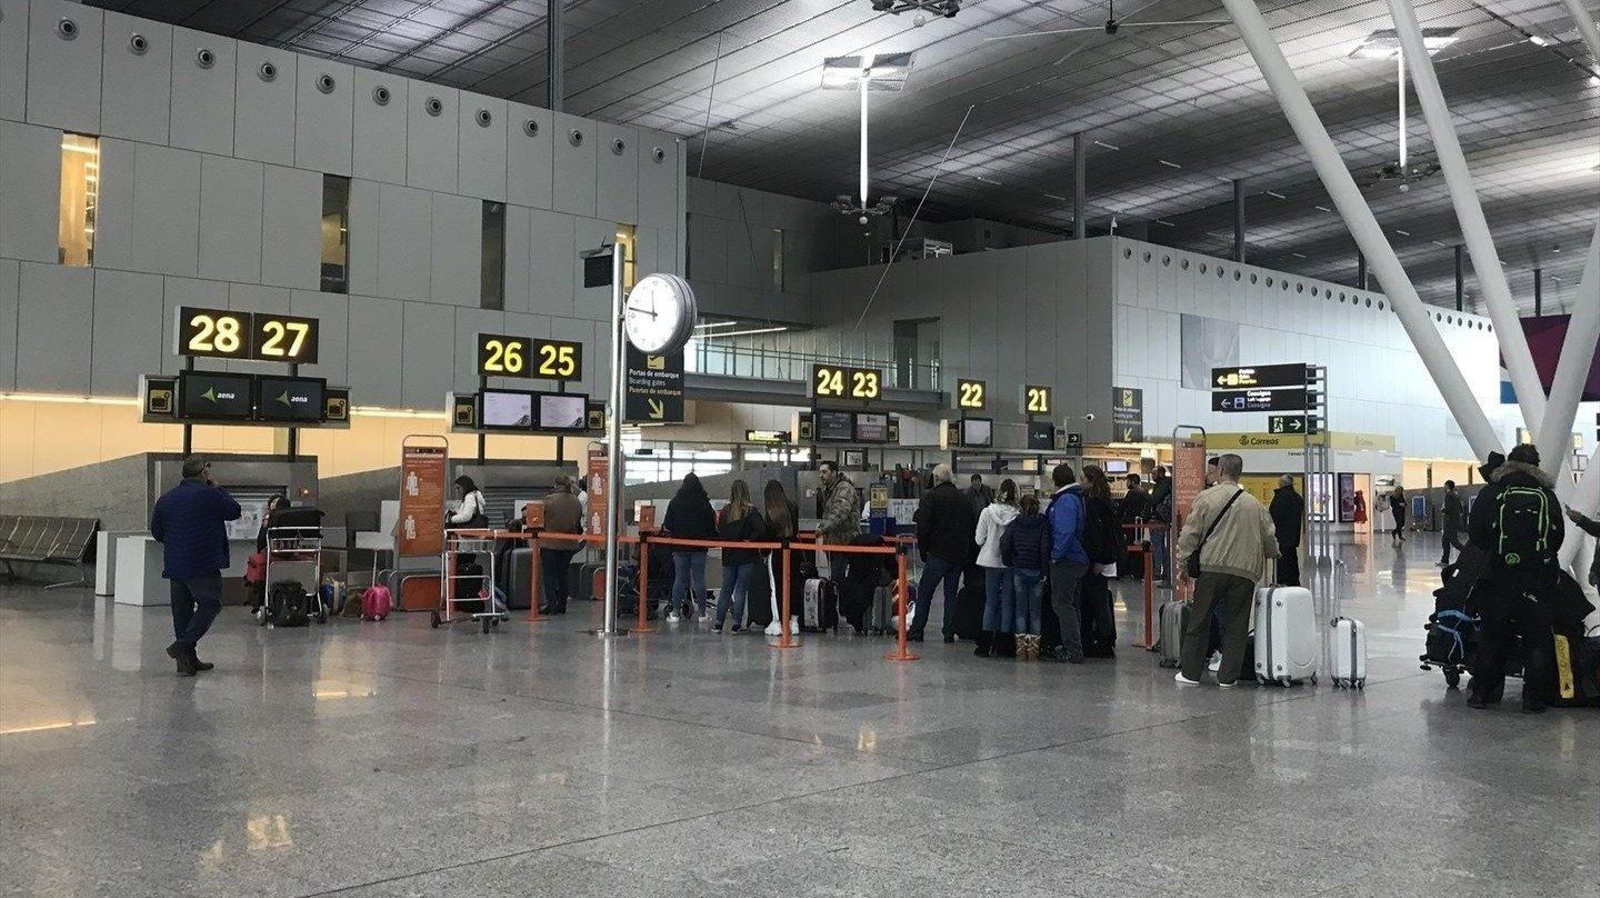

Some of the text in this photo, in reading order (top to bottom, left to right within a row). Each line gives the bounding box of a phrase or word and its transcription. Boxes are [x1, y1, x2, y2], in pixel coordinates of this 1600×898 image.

[188, 314, 240, 353] 28
[261, 320, 309, 357] 27
[484, 340, 523, 373] 26
[539, 344, 575, 376] 25
[816, 368, 844, 396] 24
[852, 371, 878, 398] 23
[960, 382, 983, 408] 22
[1027, 388, 1048, 412] 21
[1250, 437, 1279, 446] Correos
